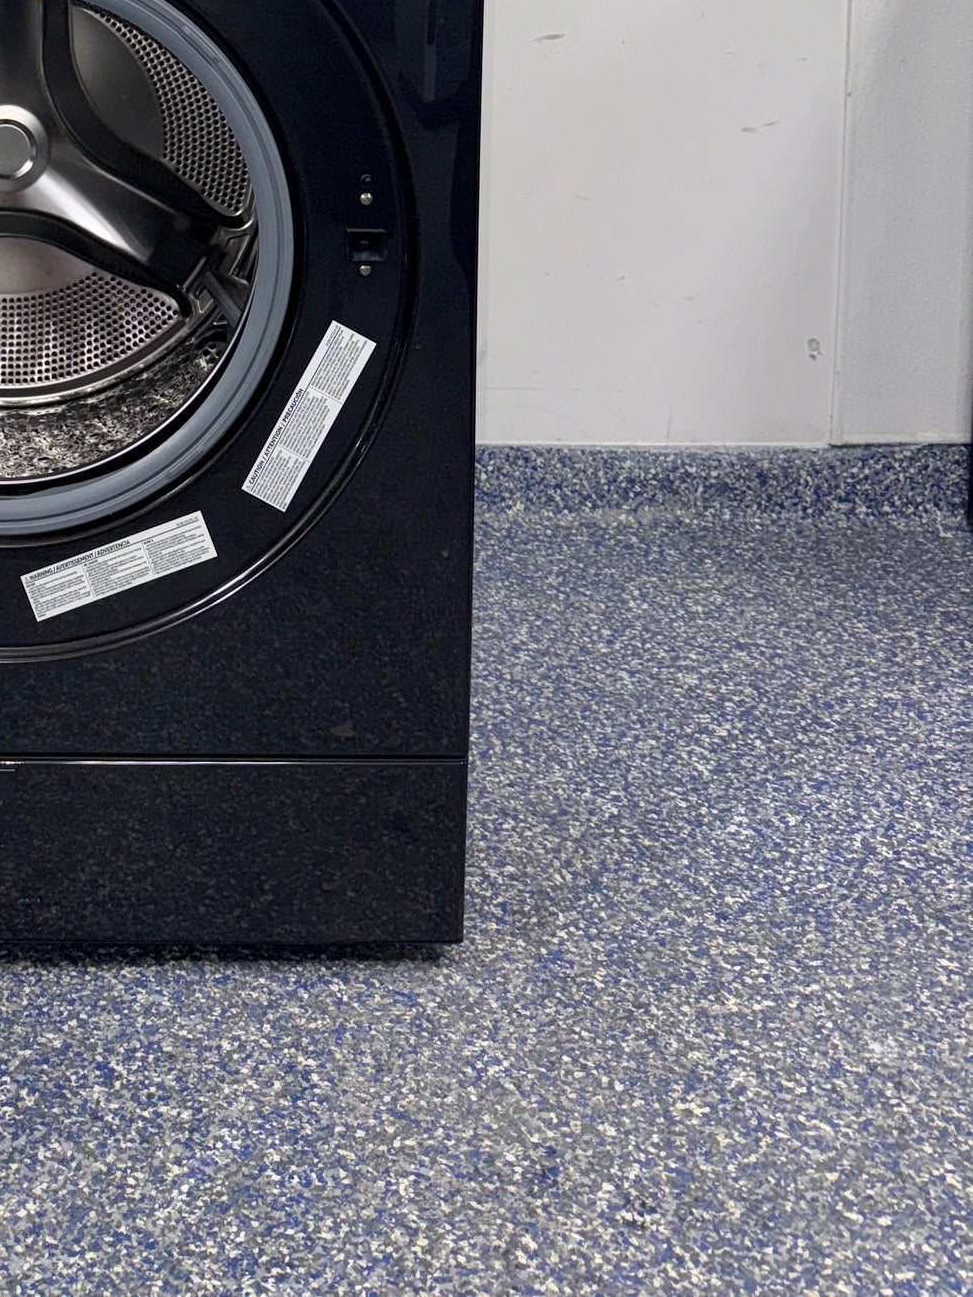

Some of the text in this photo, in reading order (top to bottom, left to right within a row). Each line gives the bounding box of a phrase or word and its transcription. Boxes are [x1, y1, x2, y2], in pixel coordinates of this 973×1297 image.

[248, 459, 264, 485] CAUTION
[264, 426, 283, 456] ATTENTION
[282, 388, 304, 423] PRECAUCIÓN
[29, 568, 53, 581] WARNING
[56, 553, 94, 573] AVERTISSEMENT
[97, 540, 131, 556] ADVERTENCIA
